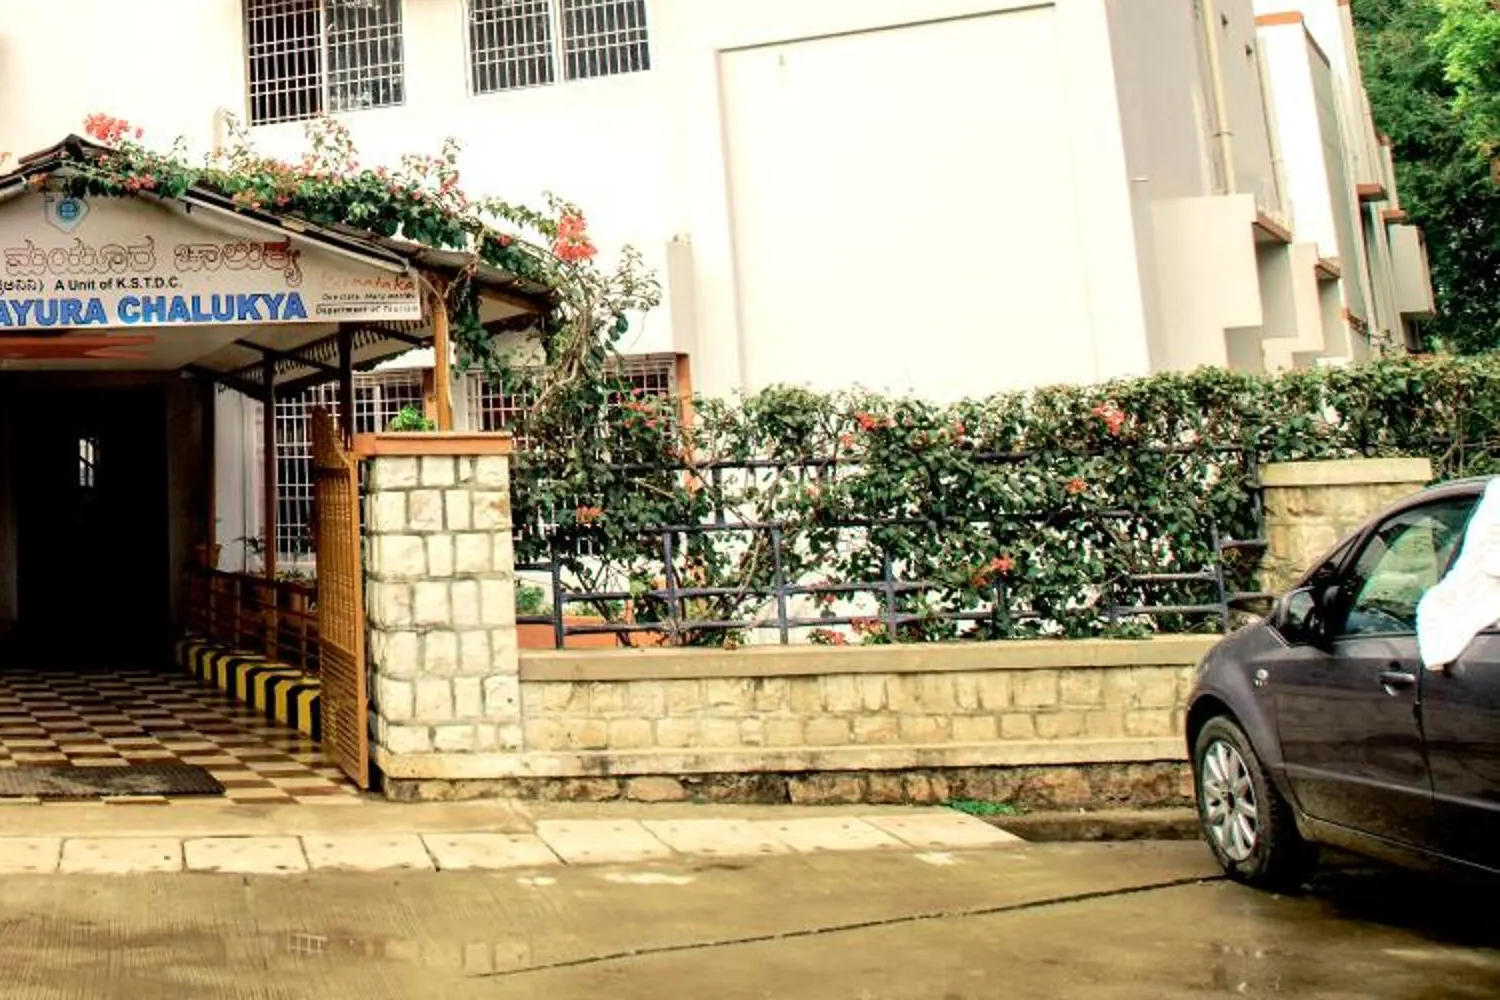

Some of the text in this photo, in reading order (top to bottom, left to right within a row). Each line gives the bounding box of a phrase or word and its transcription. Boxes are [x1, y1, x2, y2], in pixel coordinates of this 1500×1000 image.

[4, 235, 157, 276] ಮಯೂರ
[174, 235, 303, 288] ಚಾಲುಕ್ಯ
[54, 280, 65, 291] A
[69, 279, 95, 291] Unit
[99, 278, 114, 290] of
[118, 292, 308, 324] CHALUKYA
[316, 304, 367, 316] Department
